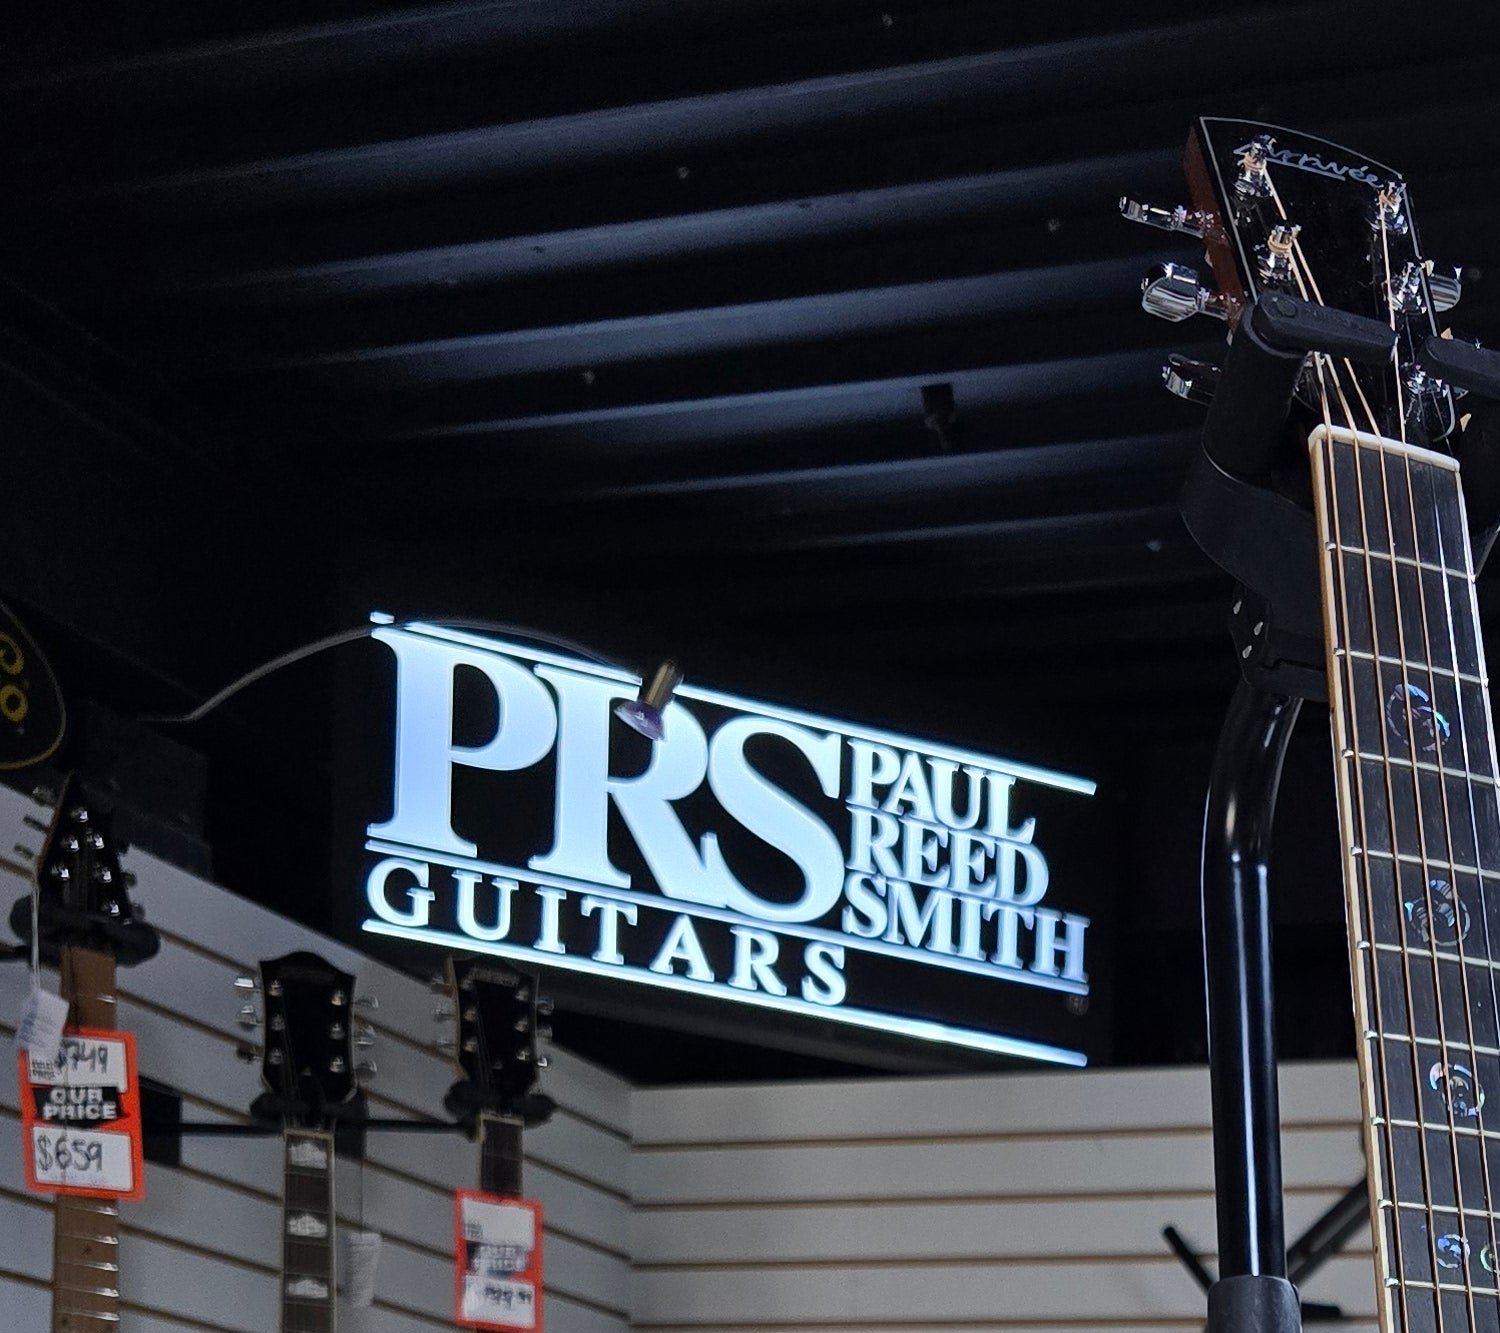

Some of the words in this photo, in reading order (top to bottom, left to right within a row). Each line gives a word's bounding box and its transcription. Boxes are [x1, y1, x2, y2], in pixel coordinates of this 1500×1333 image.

[367, 626, 847, 924] PRS
[847, 737, 1036, 842] PAUL
[847, 805, 1050, 908] REED
[366, 857, 847, 1006] GUITARS
[844, 873, 1090, 980] SMITH
[42, 1103, 118, 1121] PRICE
[50, 1085, 104, 1105] OUR
[36, 1132, 104, 1174] $659
